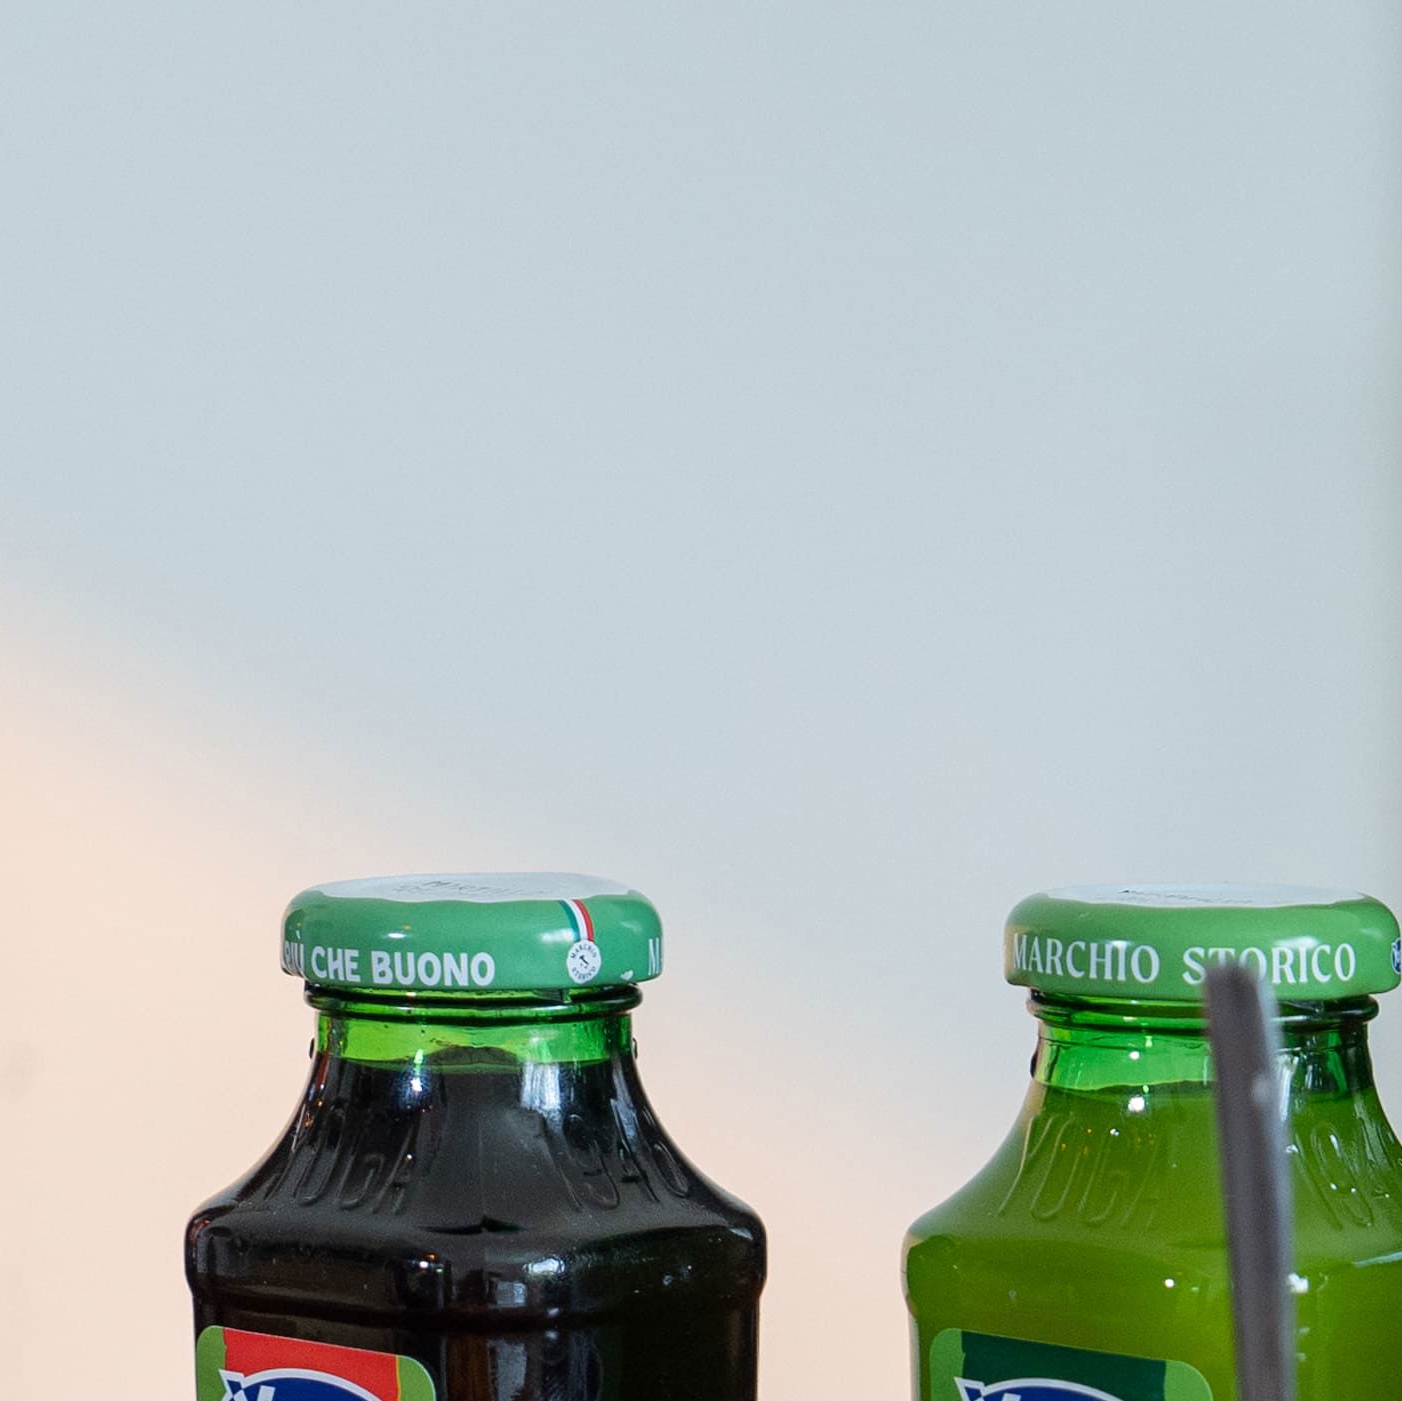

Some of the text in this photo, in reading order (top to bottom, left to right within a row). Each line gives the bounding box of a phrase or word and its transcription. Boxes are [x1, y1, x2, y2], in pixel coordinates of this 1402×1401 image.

[311, 945, 361, 983] CHE
[371, 950, 496, 987] BUONO
[1013, 932, 1160, 984] MARCHIO
[1181, 943, 1357, 985] STORICO
